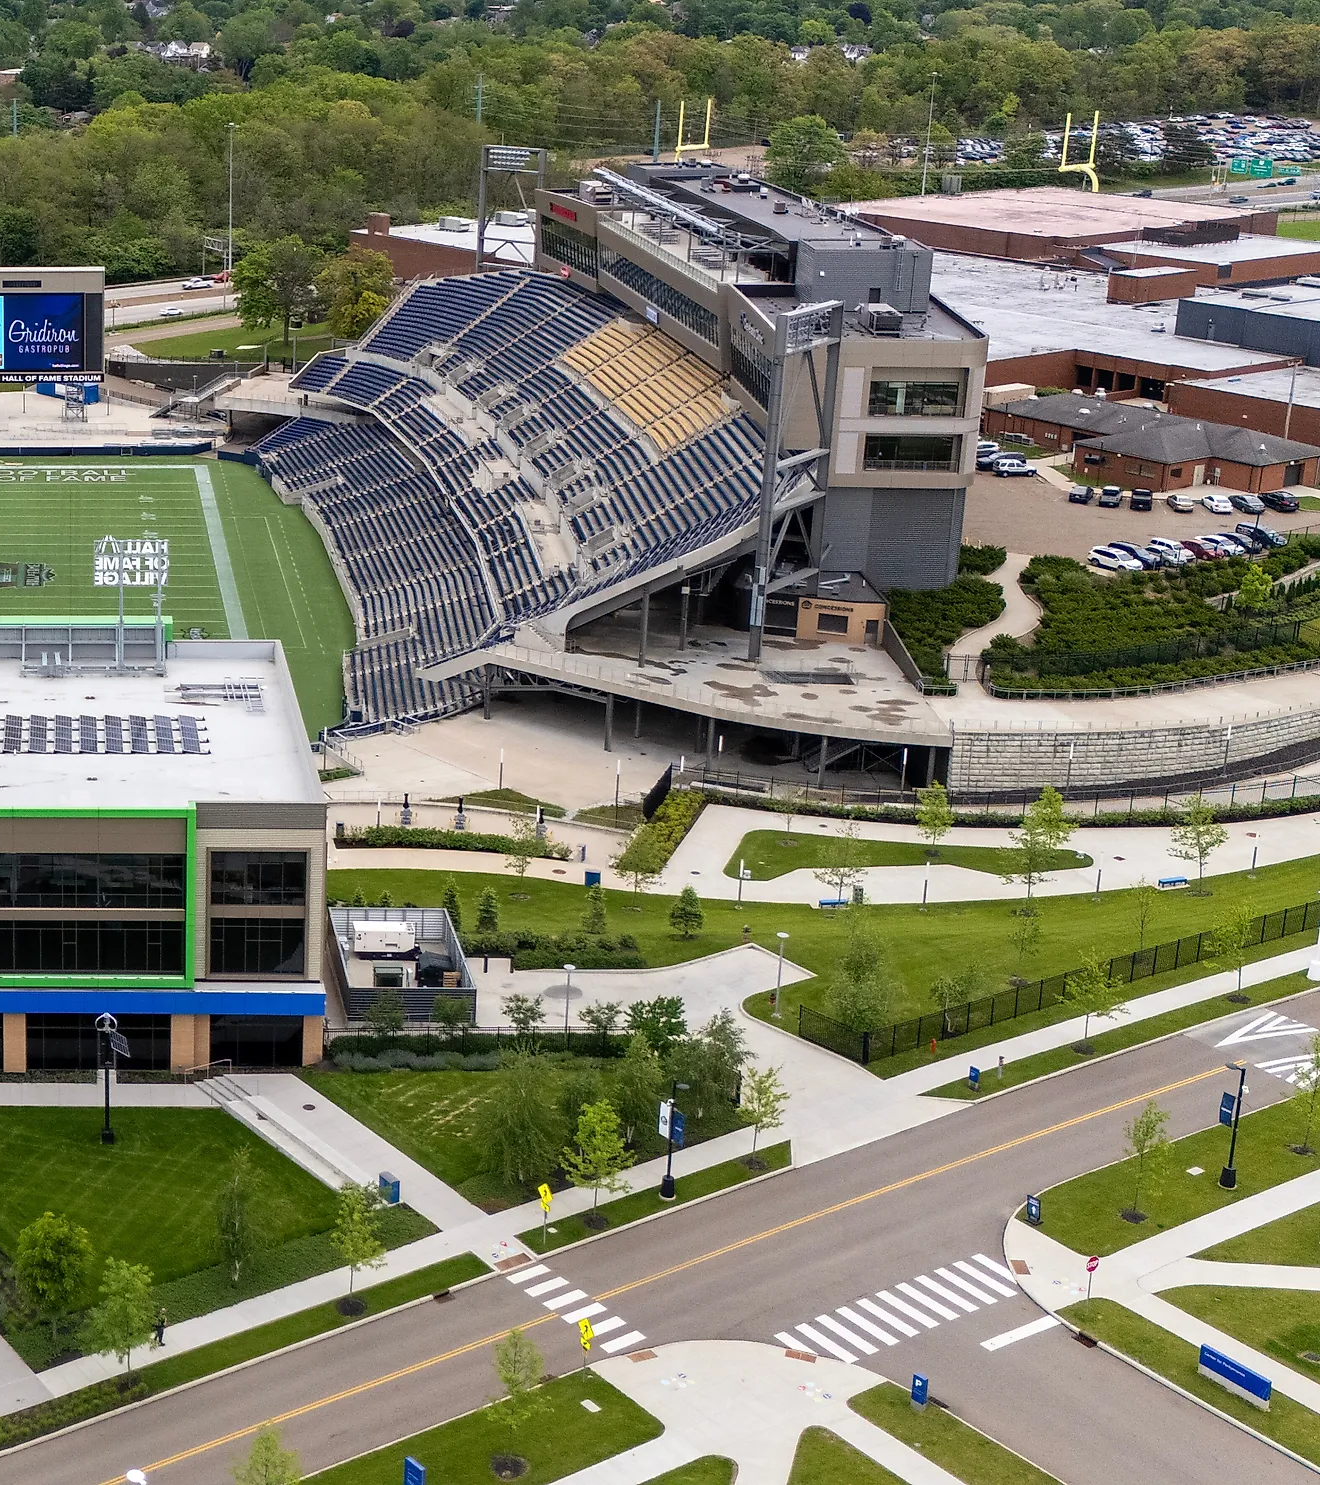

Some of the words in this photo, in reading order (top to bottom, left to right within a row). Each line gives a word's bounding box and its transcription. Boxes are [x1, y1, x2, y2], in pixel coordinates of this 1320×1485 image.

[9, 319, 79, 343] Gridiron
[18, 345, 70, 354] GASTROPUB
[814, 604, 854, 612] CONCESSIONS
[1087, 1260, 1099, 1269] STOP
